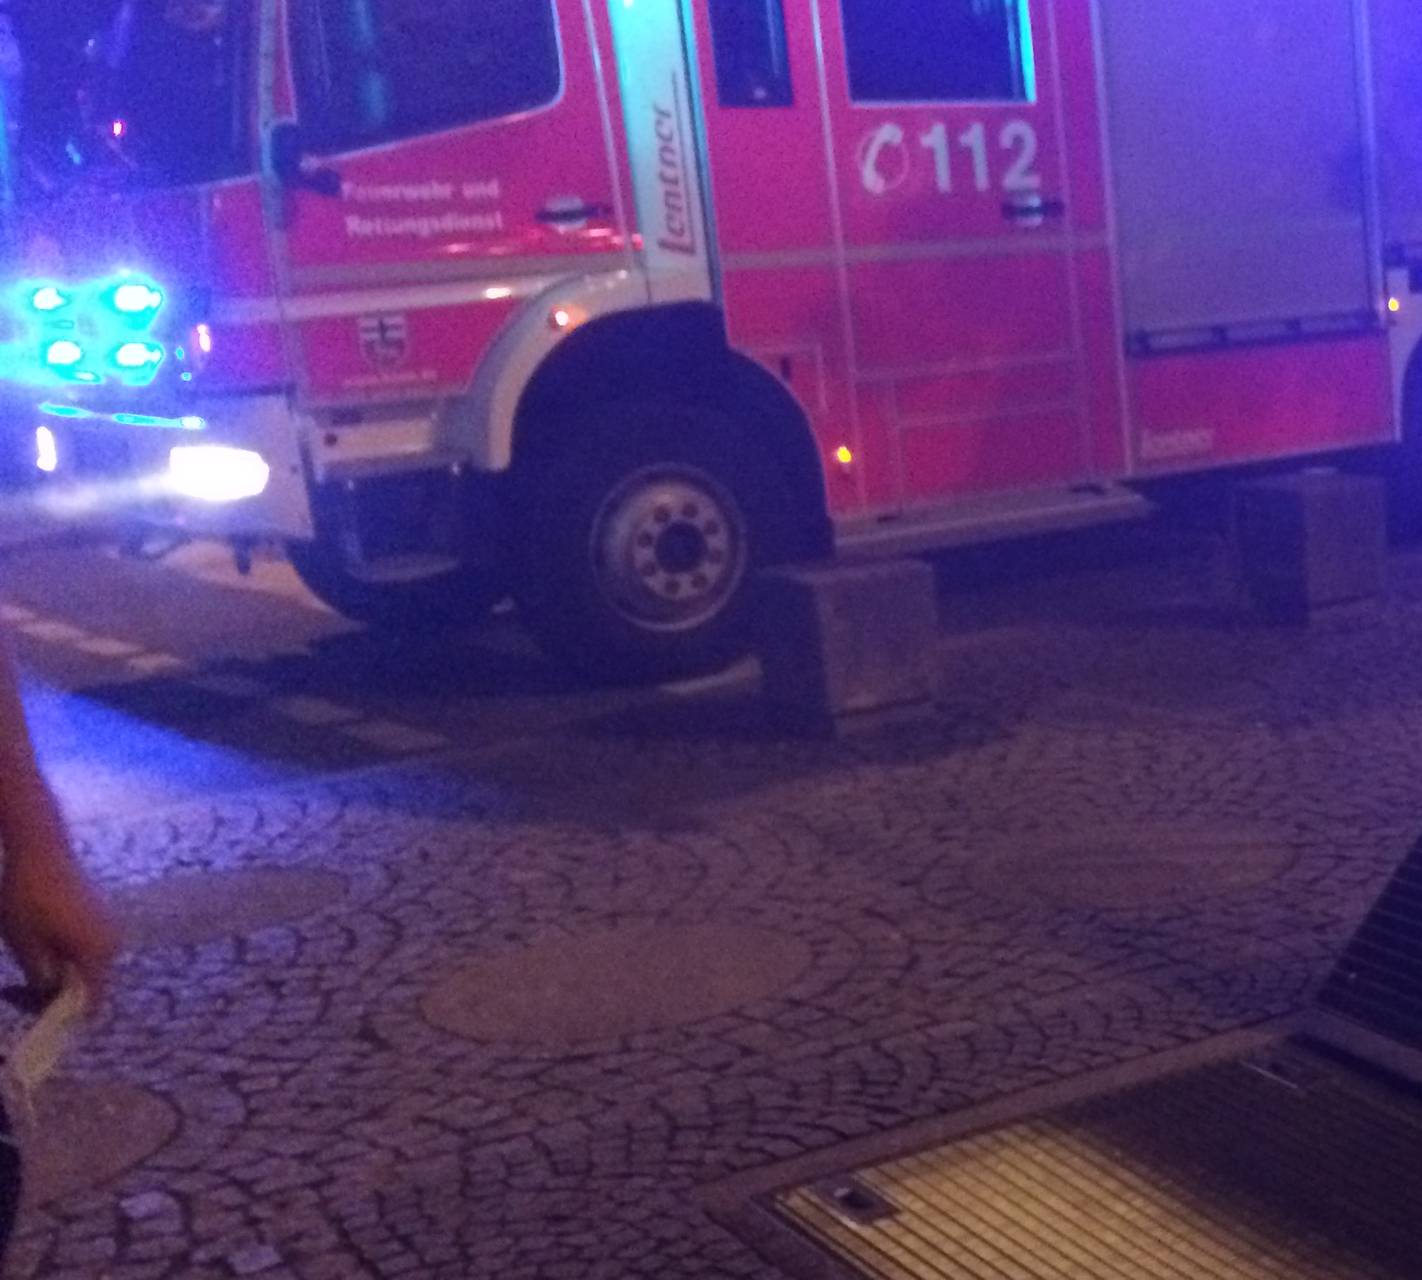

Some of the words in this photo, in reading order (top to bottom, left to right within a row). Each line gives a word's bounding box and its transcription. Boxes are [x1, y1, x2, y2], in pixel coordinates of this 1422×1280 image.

[654, 103, 696, 256] Lentner
[920, 120, 1041, 193] 112
[463, 178, 499, 198] und
[345, 211, 503, 236] Rettungsdienst
